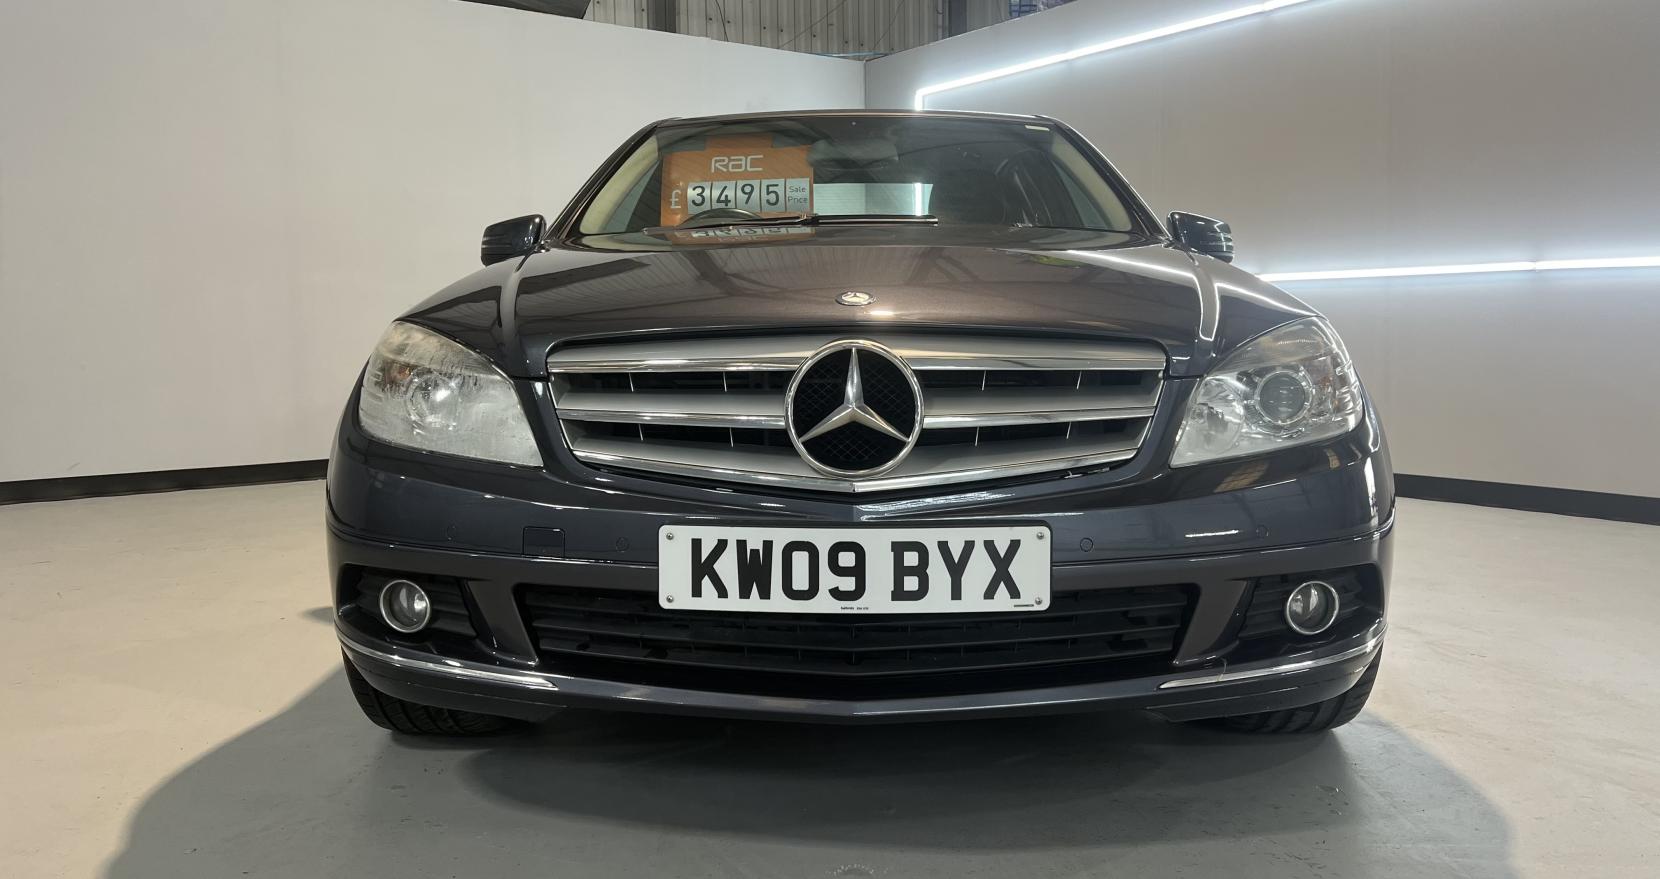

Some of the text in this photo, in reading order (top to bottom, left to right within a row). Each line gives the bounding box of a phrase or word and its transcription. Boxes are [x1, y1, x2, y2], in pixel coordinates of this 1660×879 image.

[788, 185, 806, 193] Sale
[787, 196, 808, 205] Price
[690, 538, 1022, 602] KW09 BYX
